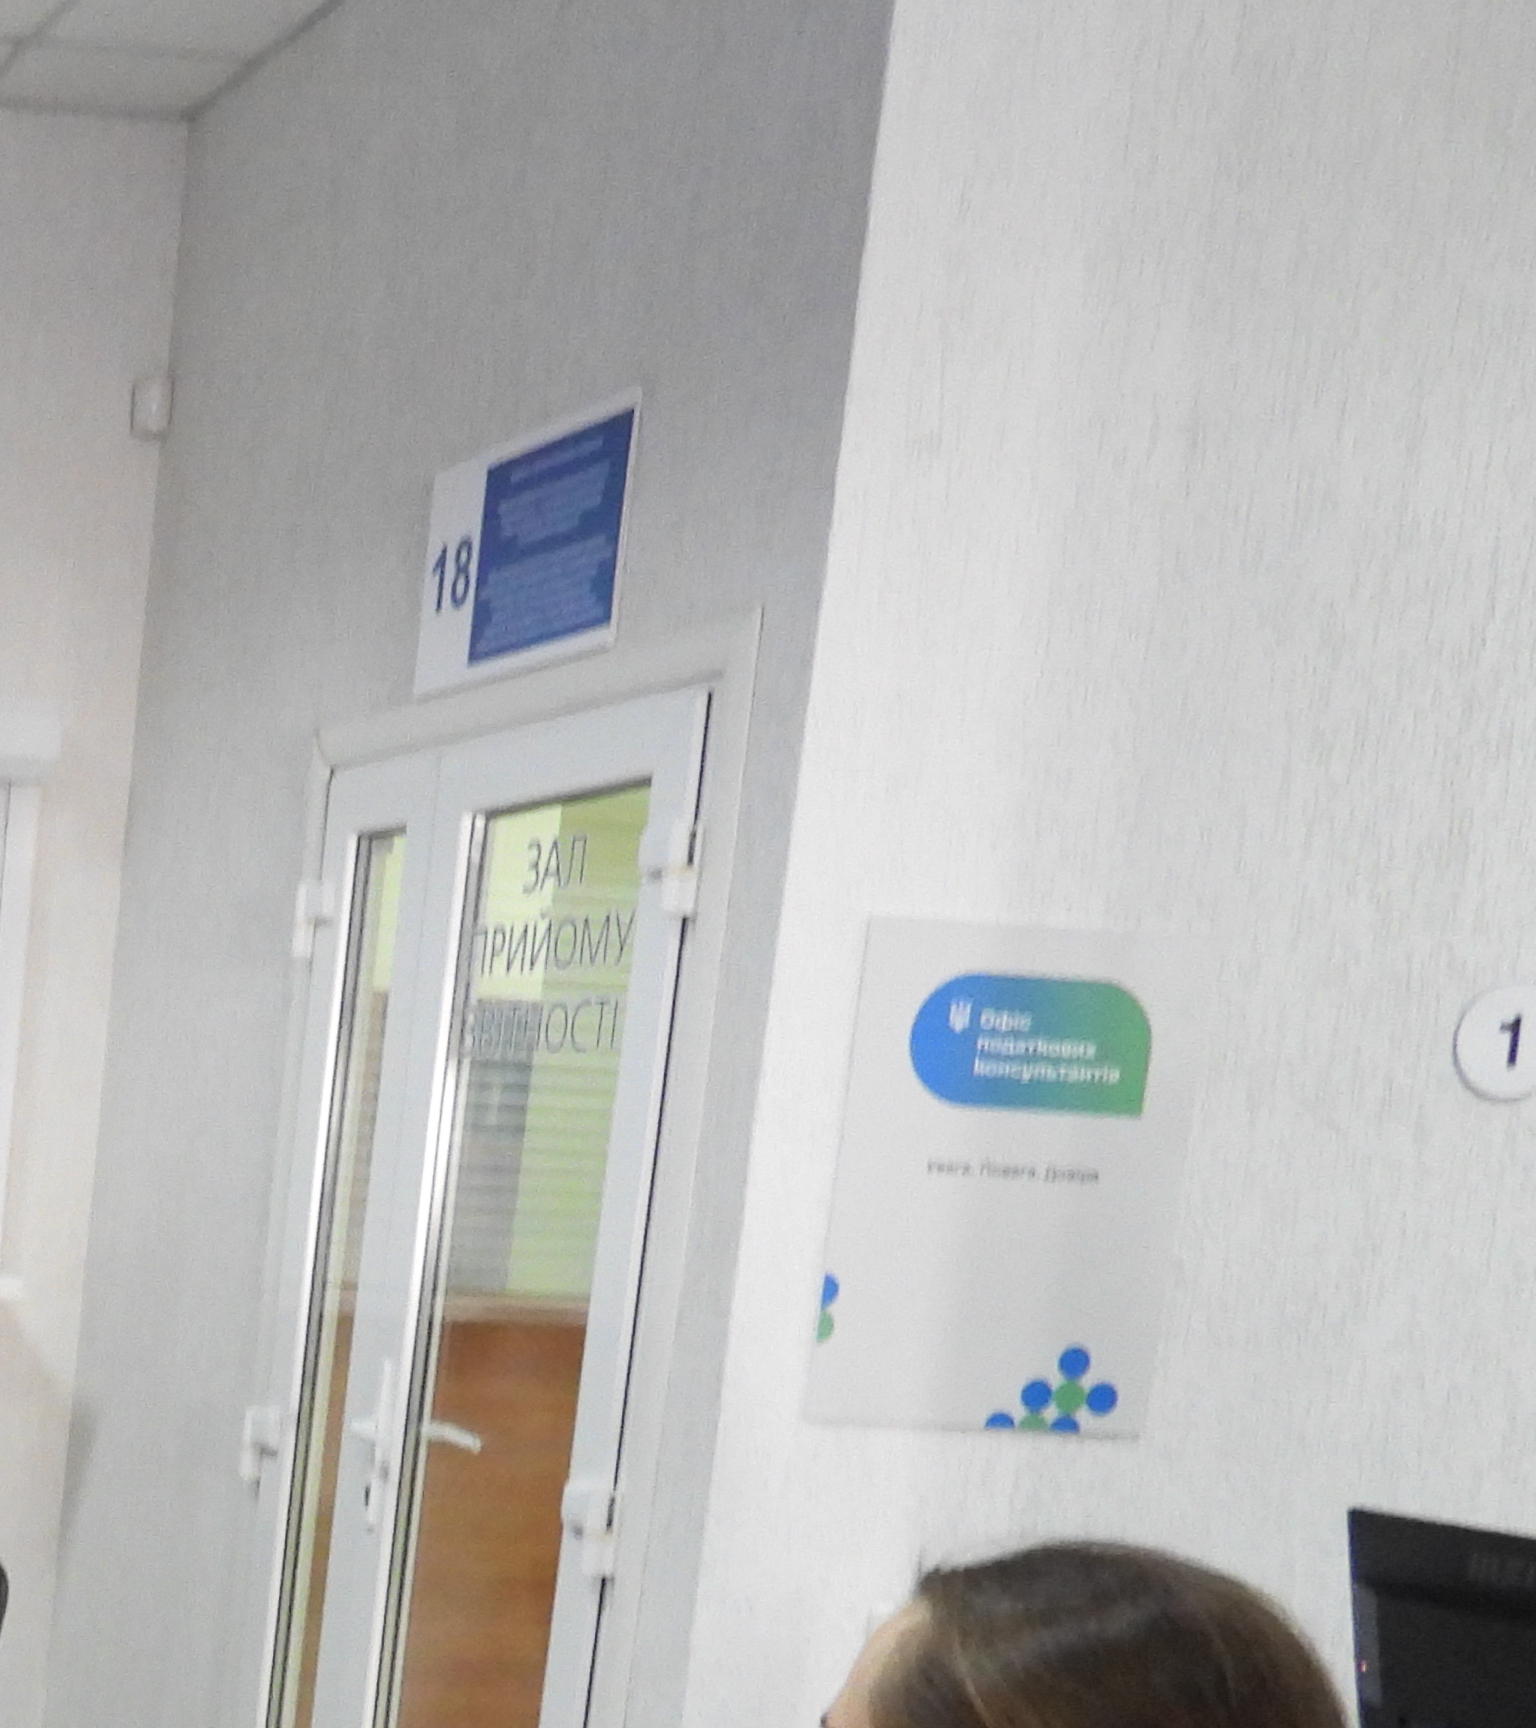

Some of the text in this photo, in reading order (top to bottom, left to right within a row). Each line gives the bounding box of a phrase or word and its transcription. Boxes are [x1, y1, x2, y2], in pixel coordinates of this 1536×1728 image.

[432, 536, 473, 614] 18
[523, 834, 588, 893] ЗАЛ
[473, 907, 636, 977] ПРИЙОМУ
[1499, 1012, 1522, 1070] 1
